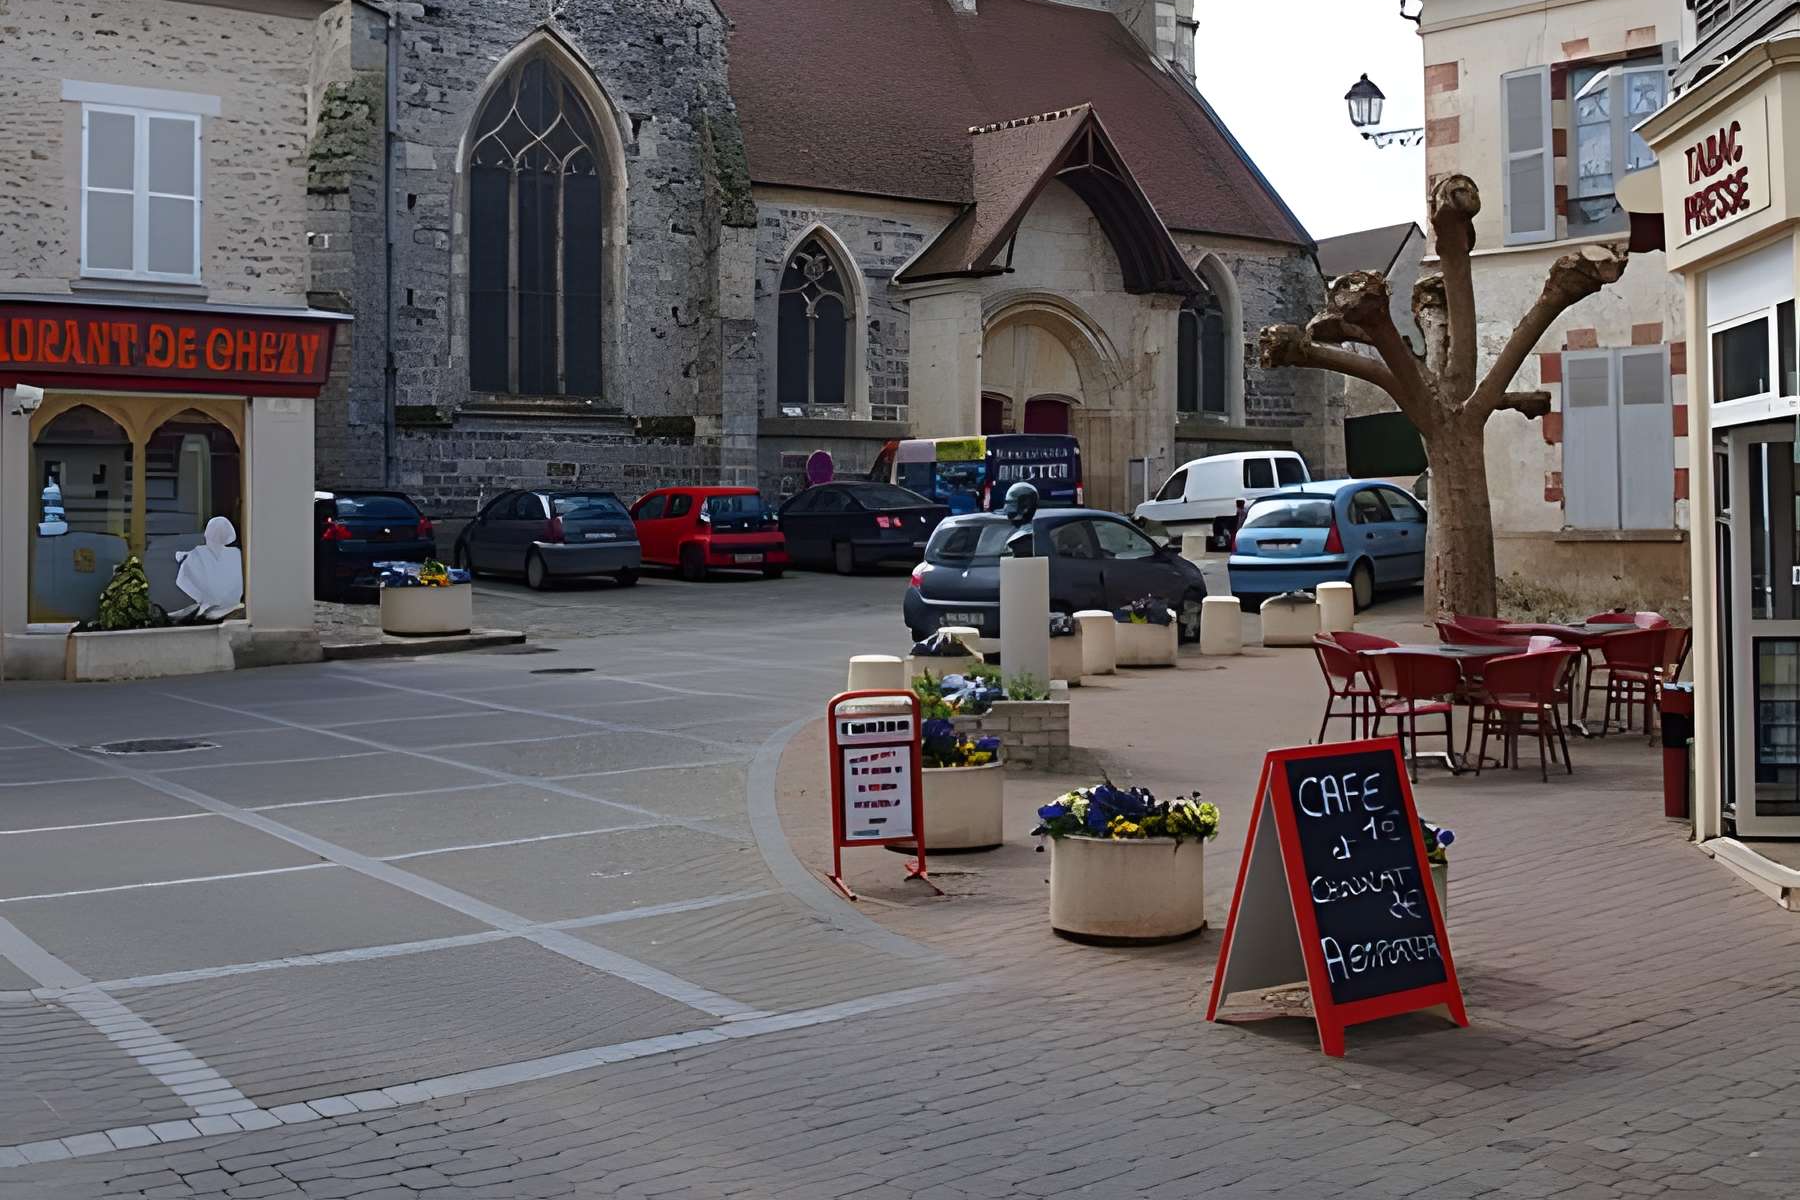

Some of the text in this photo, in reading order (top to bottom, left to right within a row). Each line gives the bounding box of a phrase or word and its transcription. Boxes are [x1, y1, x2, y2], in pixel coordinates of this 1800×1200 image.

[1684, 120, 1743, 184] TABAC
[1684, 166, 1750, 236] PRESSE
[146, 323, 197, 370] DE
[1299, 773, 1384, 817] CAFE
